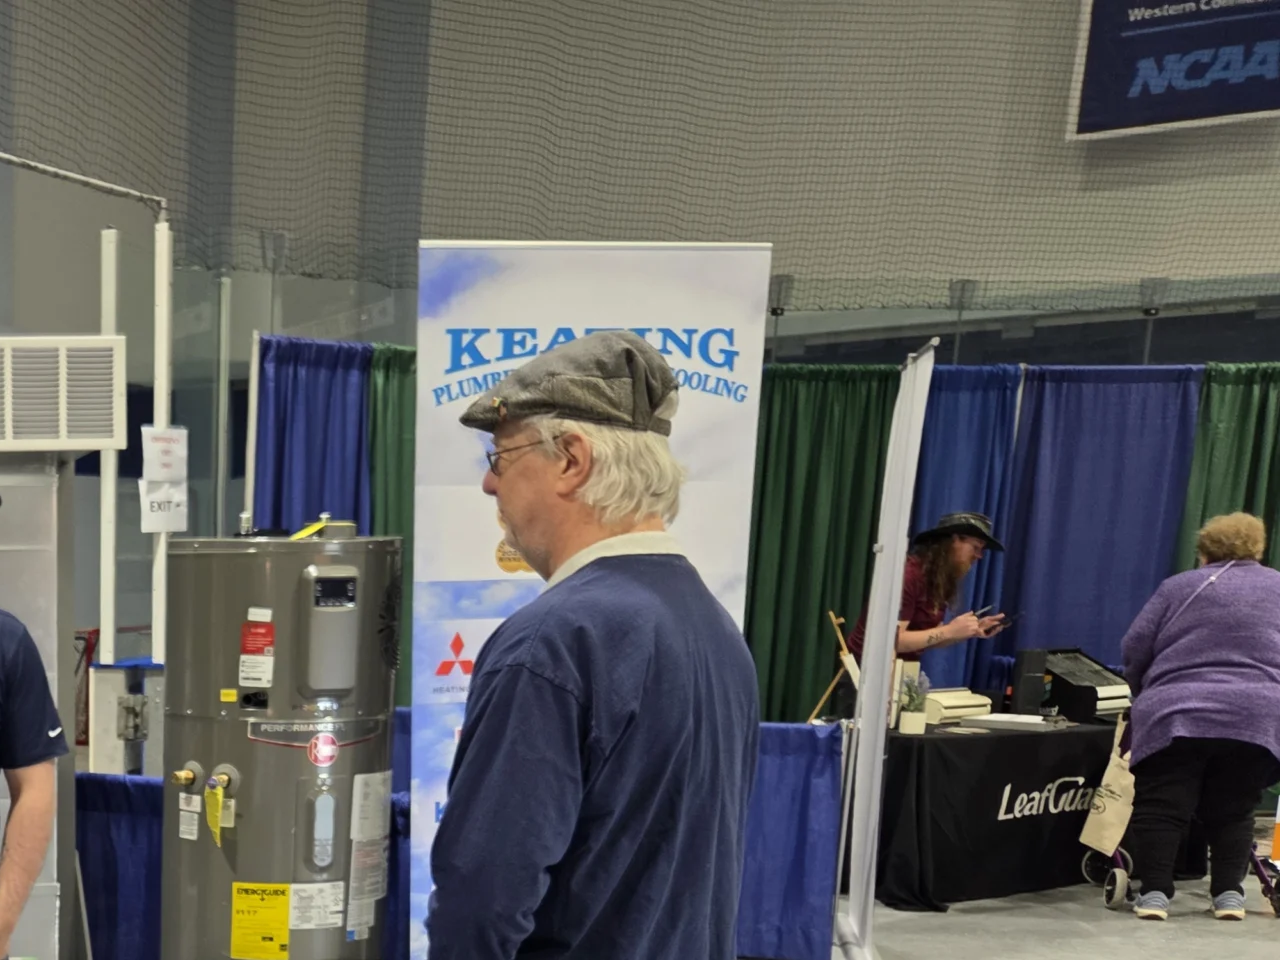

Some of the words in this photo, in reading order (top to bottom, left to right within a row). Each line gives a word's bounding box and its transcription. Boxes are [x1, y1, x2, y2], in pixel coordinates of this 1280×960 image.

[1127, 1, 1197, 22] Western
[1126, 39, 1280, 99] NCAA
[444, 327, 740, 375] KEANG
[671, 367, 749, 403] OOLING
[149, 501, 173, 512] EXIT
[261, 723, 334, 733] PERFORMANCE
[997, 776, 1094, 821] LeafGua
